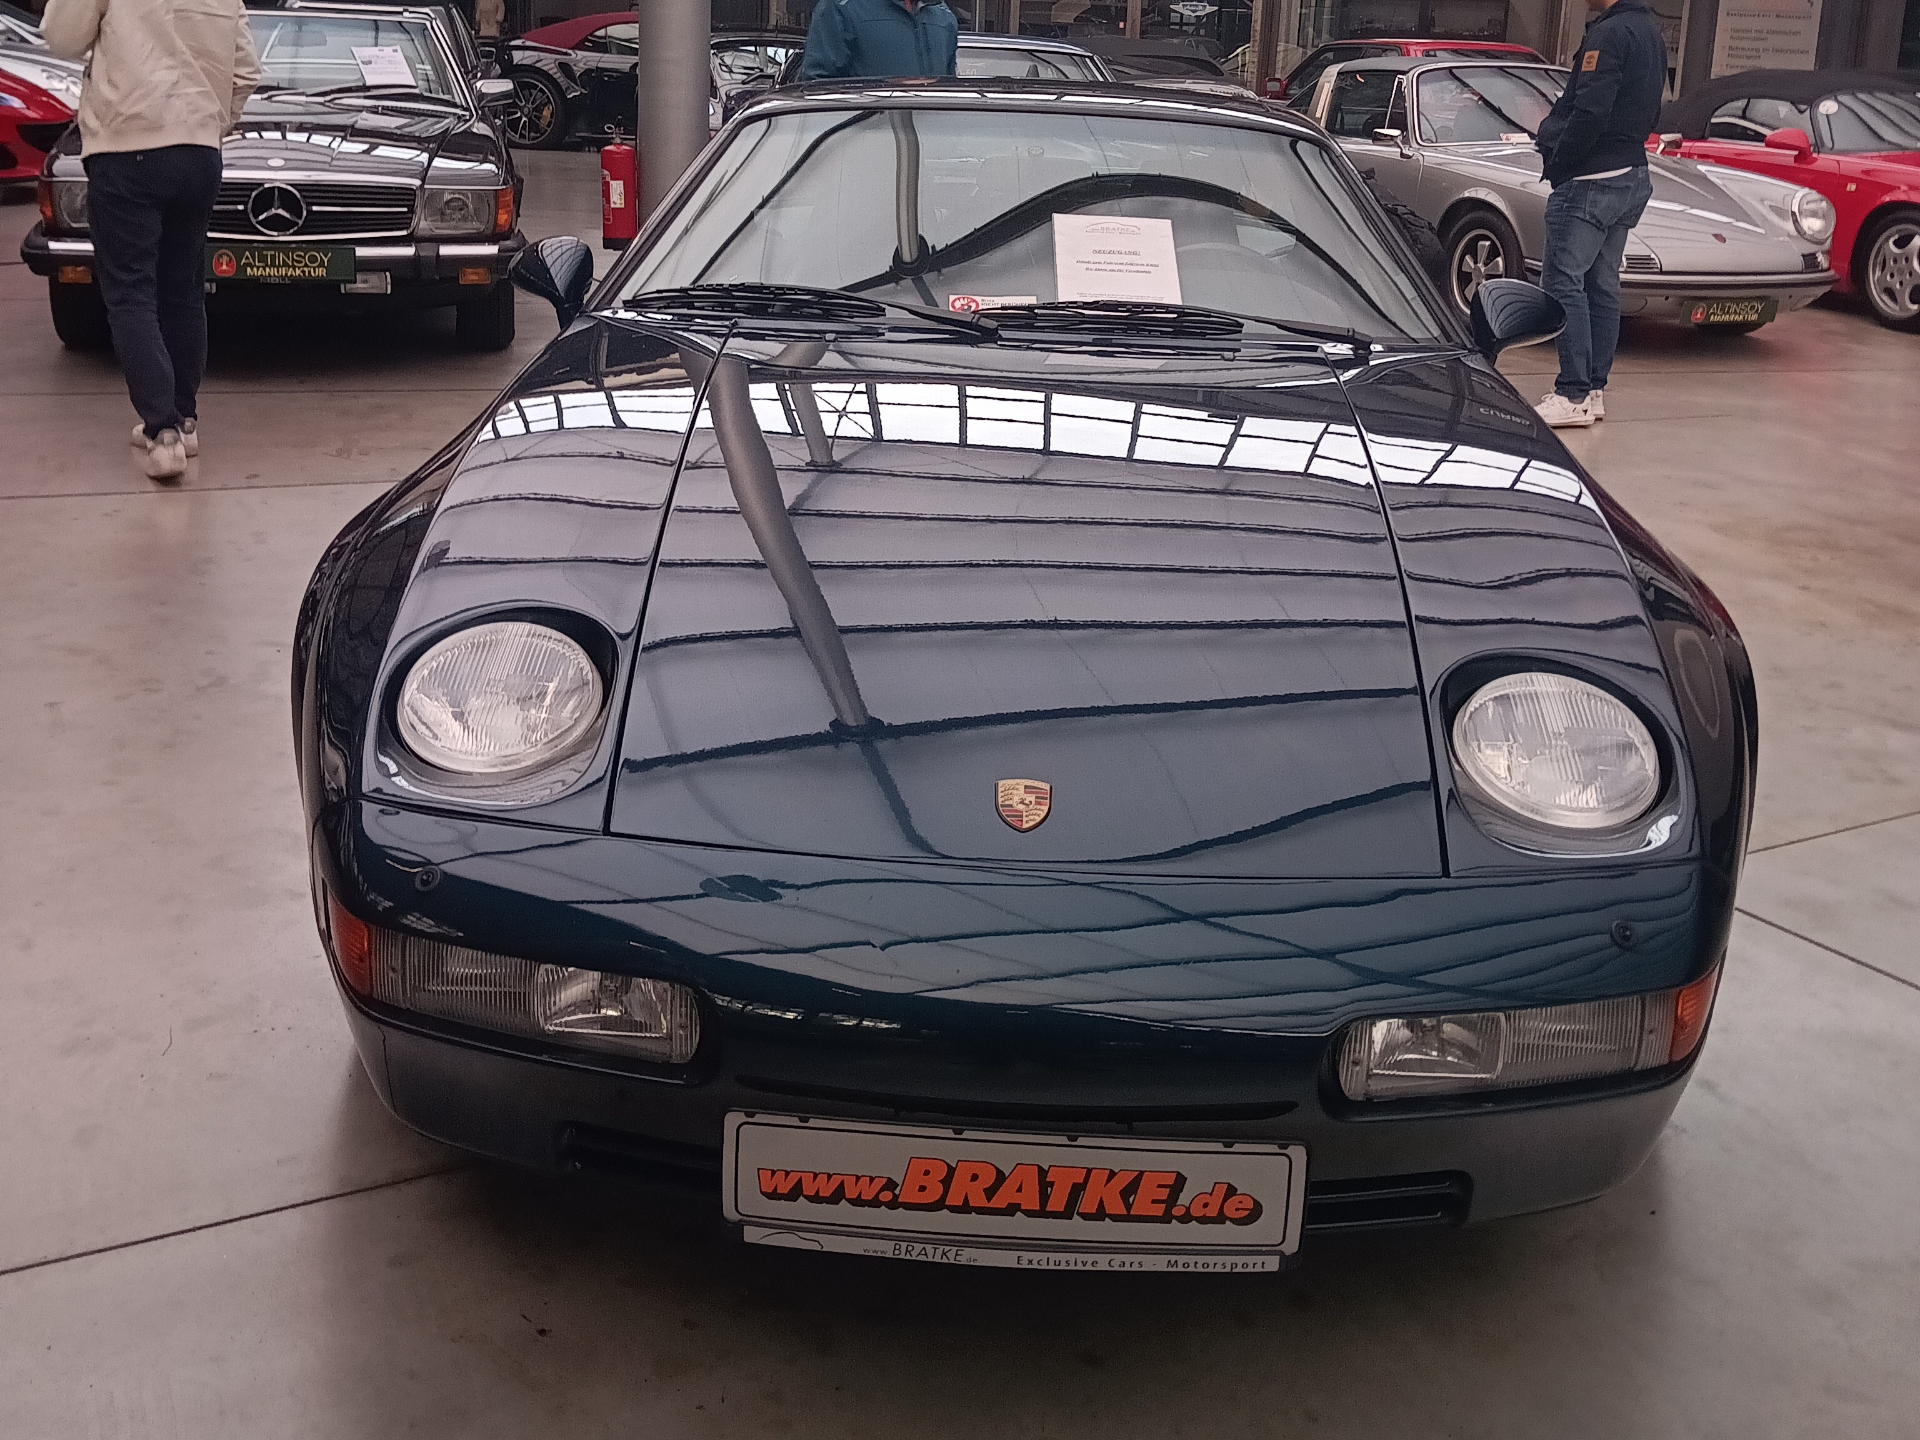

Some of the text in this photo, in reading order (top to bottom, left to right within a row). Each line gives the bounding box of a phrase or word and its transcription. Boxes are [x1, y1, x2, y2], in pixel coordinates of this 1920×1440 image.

[240, 251, 332, 267] ALTINSOY
[246, 267, 327, 278] MANUFAKTUR
[1708, 301, 1765, 315] ALTINSOY
[757, 1156, 1263, 1226] www.BRATKE.de
[862, 1242, 979, 1264] www.BRATKE.de
[1016, 1255, 1099, 1268] Exclusive
[1107, 1258, 1144, 1269] Cars
[1166, 1258, 1267, 1273] Motorsport
